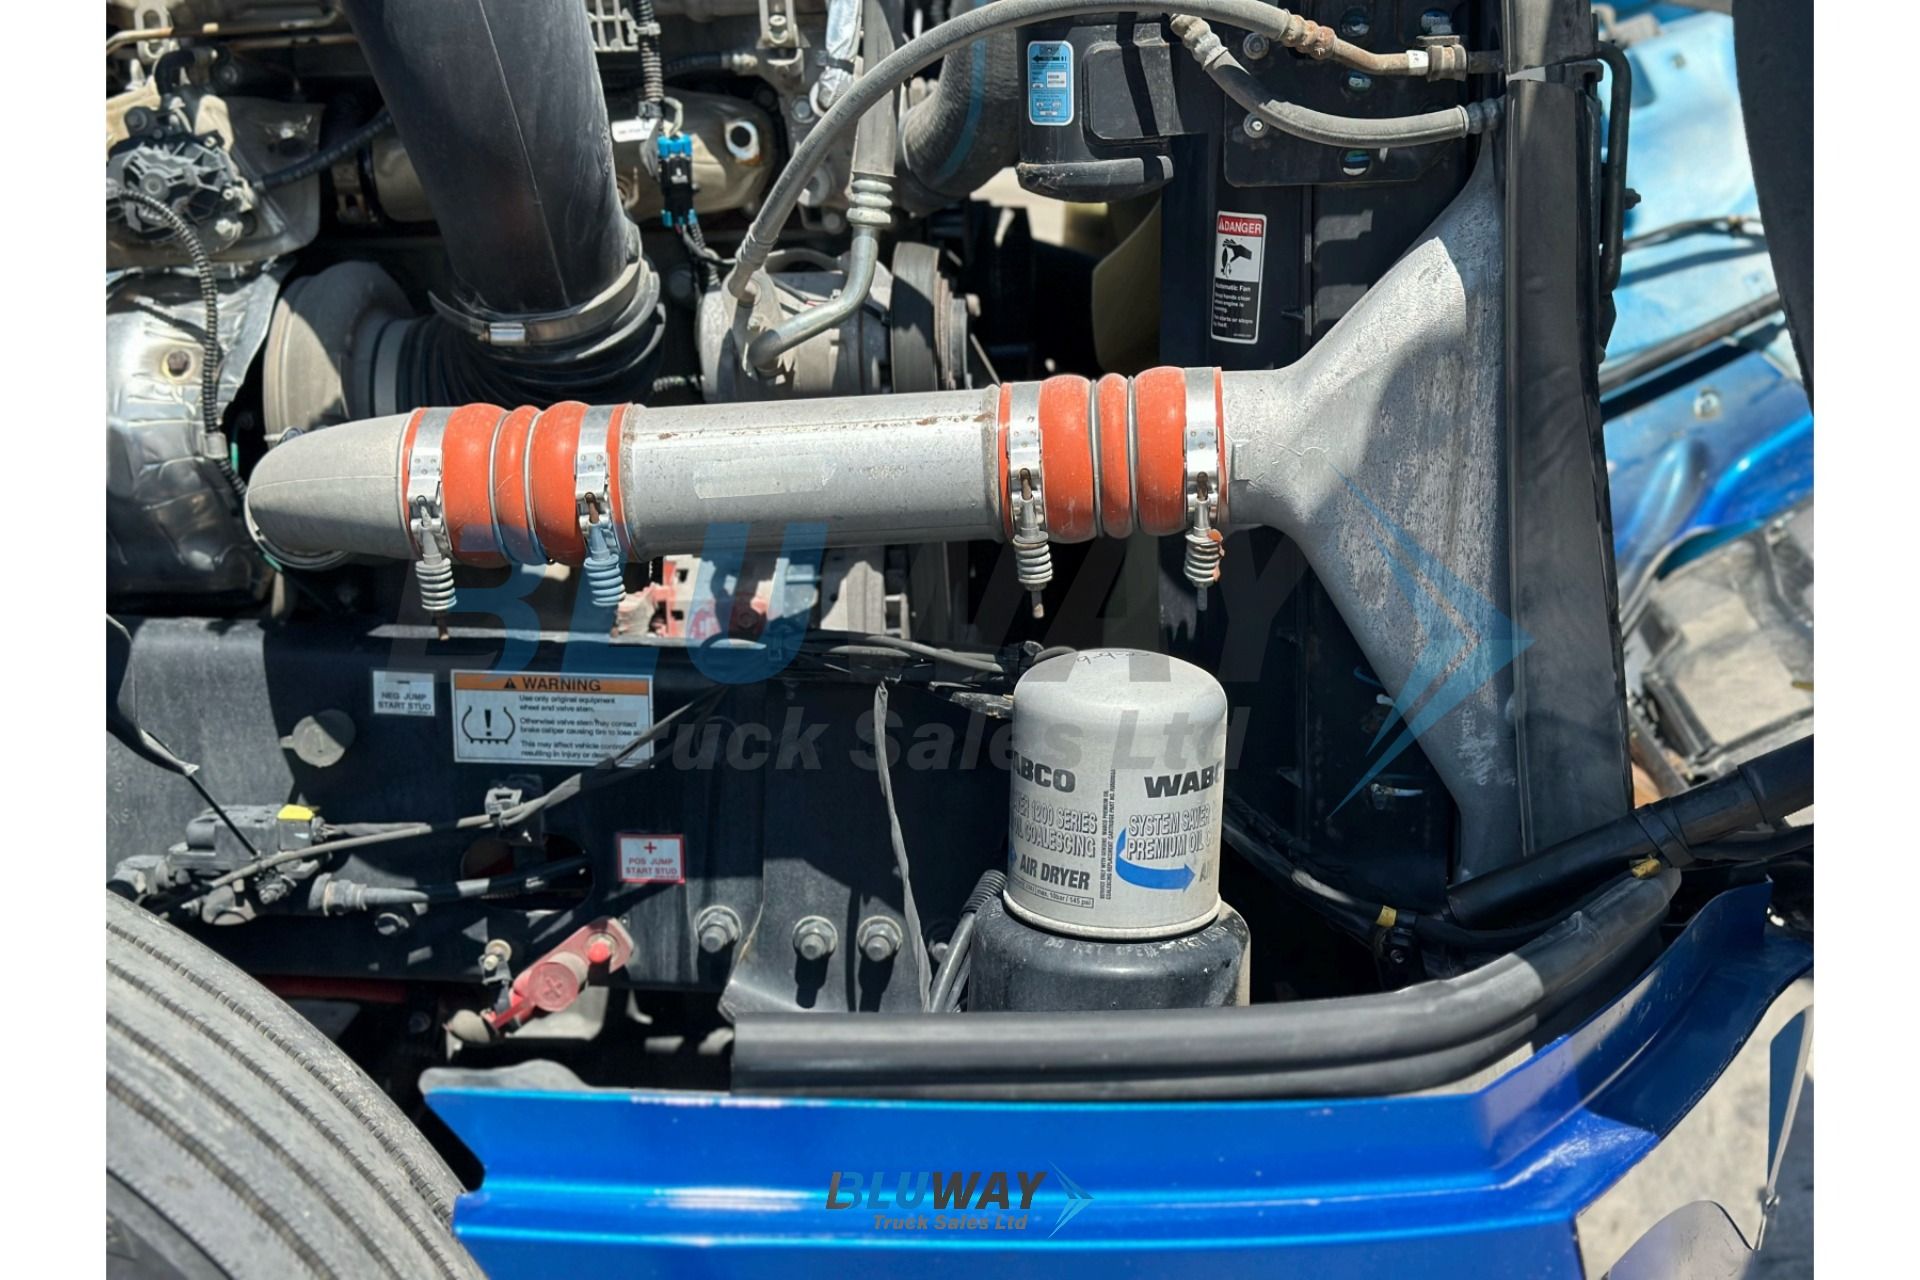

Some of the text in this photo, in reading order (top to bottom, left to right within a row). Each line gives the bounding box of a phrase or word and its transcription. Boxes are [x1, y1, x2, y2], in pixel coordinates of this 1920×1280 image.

[1224, 220, 1262, 235] DANGER
[522, 676, 601, 692] WARNING
[381, 692, 427, 701] NEG JUMP
[519, 694, 616, 705] Use only original equipment
[378, 700, 432, 710] START STUD
[520, 716, 555, 725] Otherwise
[556, 718, 575, 726] valve
[594, 720, 609, 728] may
[610, 720, 637, 728] contact
[520, 726, 540, 734] brake
[541, 727, 564, 735] caliper
[566, 728, 594, 736] causing
[520, 740, 536, 748] This
[521, 750, 552, 758] resulting
[1012, 750, 1076, 793] ABCO
[1032, 802, 1054, 827] 1200
[1058, 807, 1098, 834] SERIES
[1128, 811, 1180, 838] SYSTEM
[1025, 821, 1096, 858] COALESCING
[1127, 833, 1188, 861] PREMIUM
[1189, 831, 1204, 855] OIL
[628, 857, 646, 865] POS
[1020, 854, 1038, 878] AIR
[1040, 862, 1090, 891] DRYER
